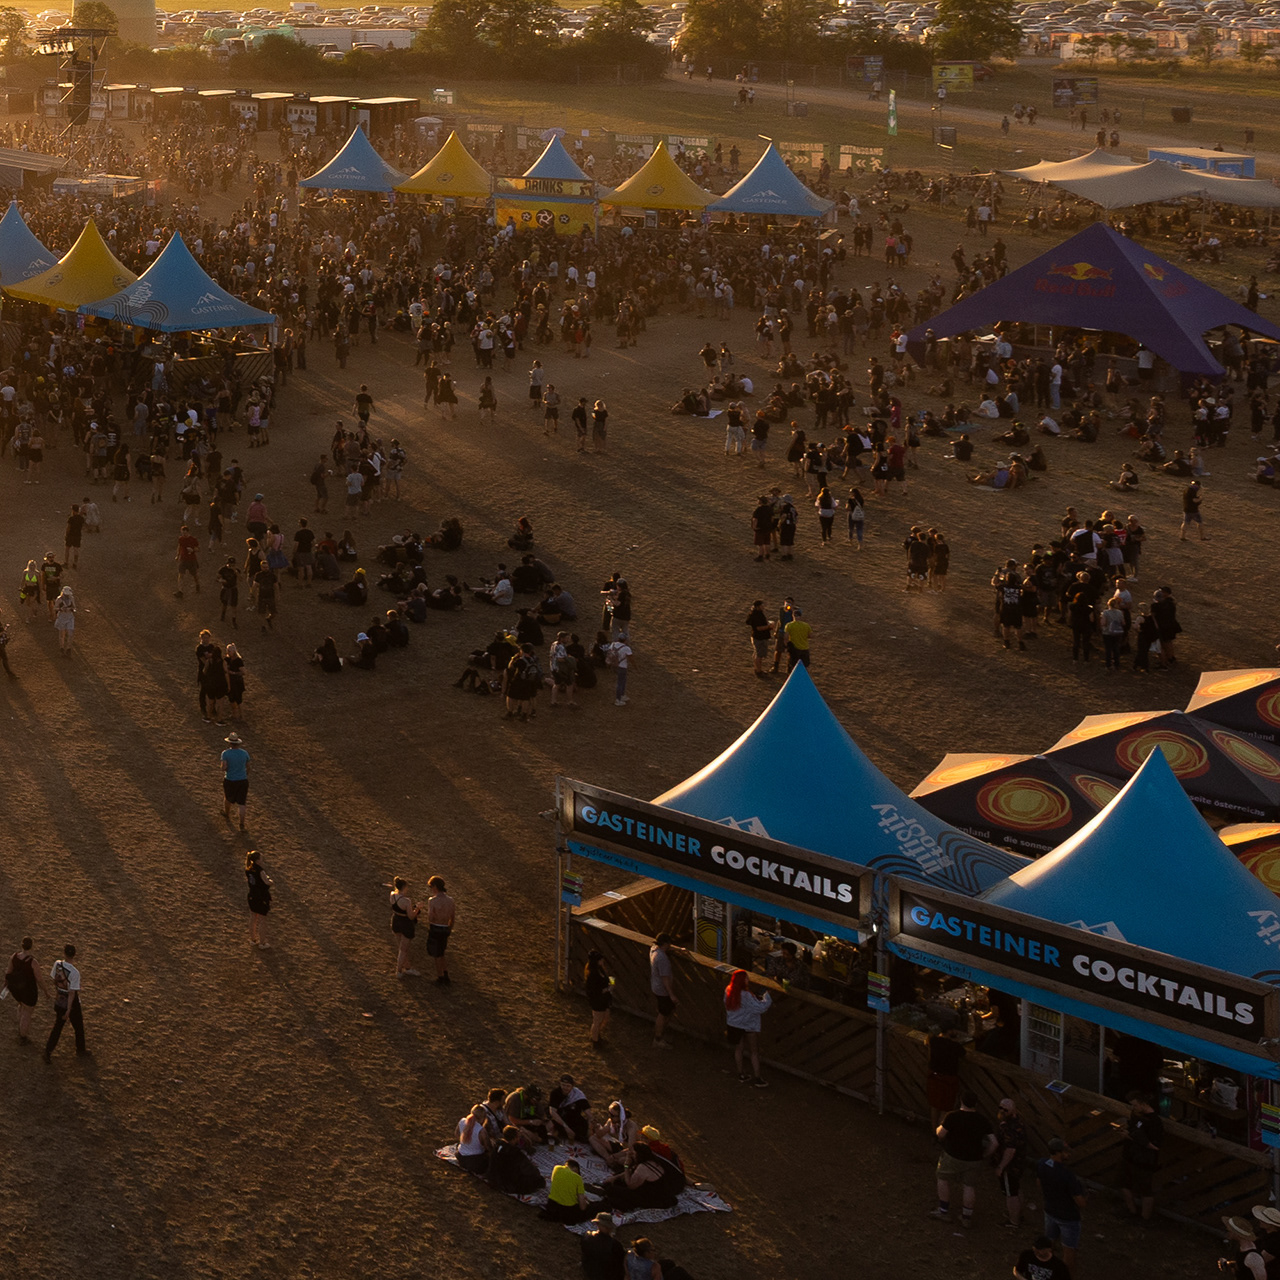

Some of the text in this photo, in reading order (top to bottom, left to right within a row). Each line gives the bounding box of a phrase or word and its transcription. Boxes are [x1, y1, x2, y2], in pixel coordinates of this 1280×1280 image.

[525, 179, 564, 194] DRINKS
[1035, 278, 1116, 297] Red Bull
[191, 304, 238, 315] GASTEINER
[1003, 834, 1019, 845] die
[581, 805, 853, 903] GASTEINER COCKTAILS
[910, 906, 1255, 1026] GASTEINER COCKTAILS
